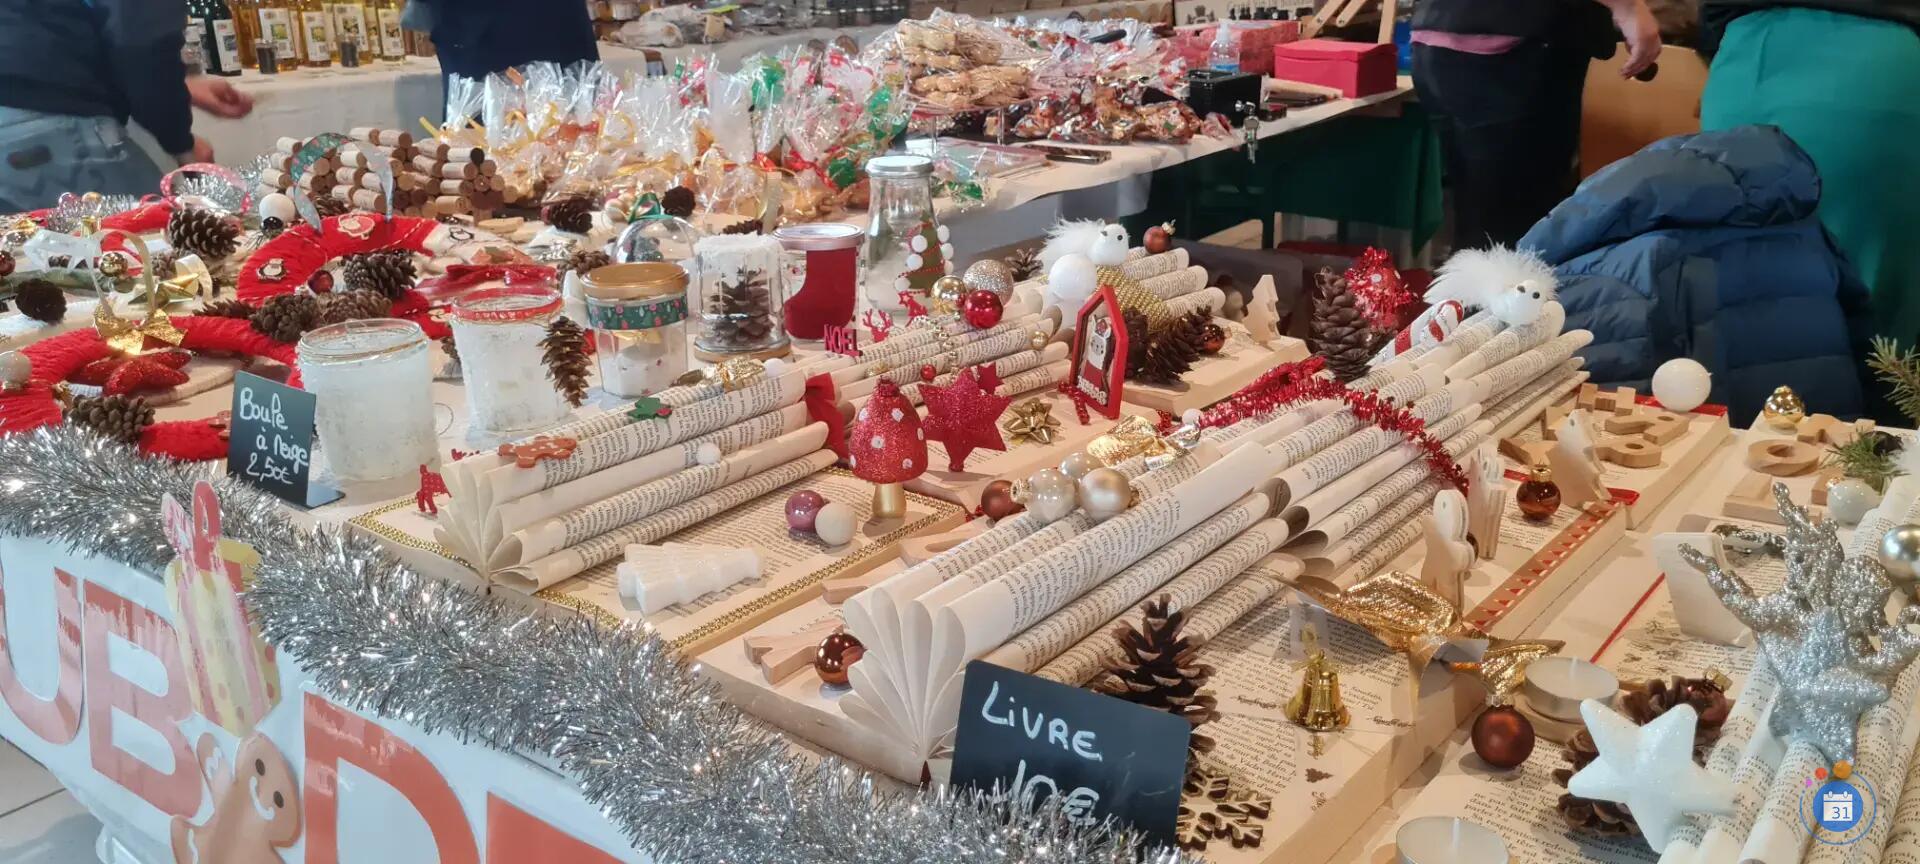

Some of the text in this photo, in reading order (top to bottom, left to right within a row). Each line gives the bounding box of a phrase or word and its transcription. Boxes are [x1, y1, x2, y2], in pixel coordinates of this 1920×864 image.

[240, 387, 288, 430] Boule
[256, 426, 268, 450] à
[246, 452, 294, 484] 2,50€
